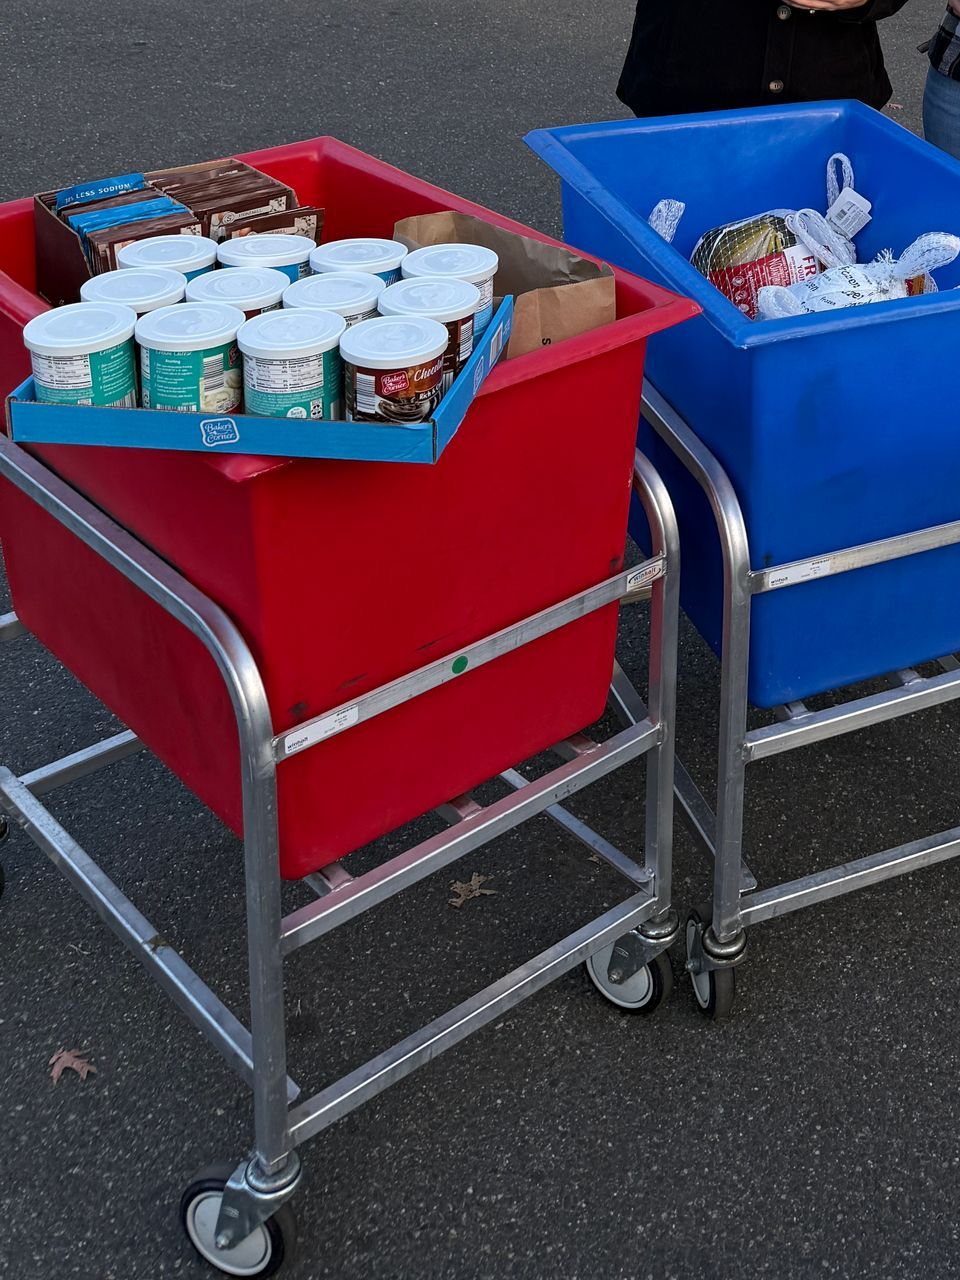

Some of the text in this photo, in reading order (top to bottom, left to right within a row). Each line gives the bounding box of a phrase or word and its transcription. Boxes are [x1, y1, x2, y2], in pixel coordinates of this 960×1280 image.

[76, 190, 95, 199] LESS
[98, 182, 131, 194] SODIUM
[820, 297, 837, 306] frozen
[383, 381, 407, 393] Corner
[419, 391, 432, 400] Rich
[206, 432, 235, 443] Corner
[287, 737, 308, 749] winholt
